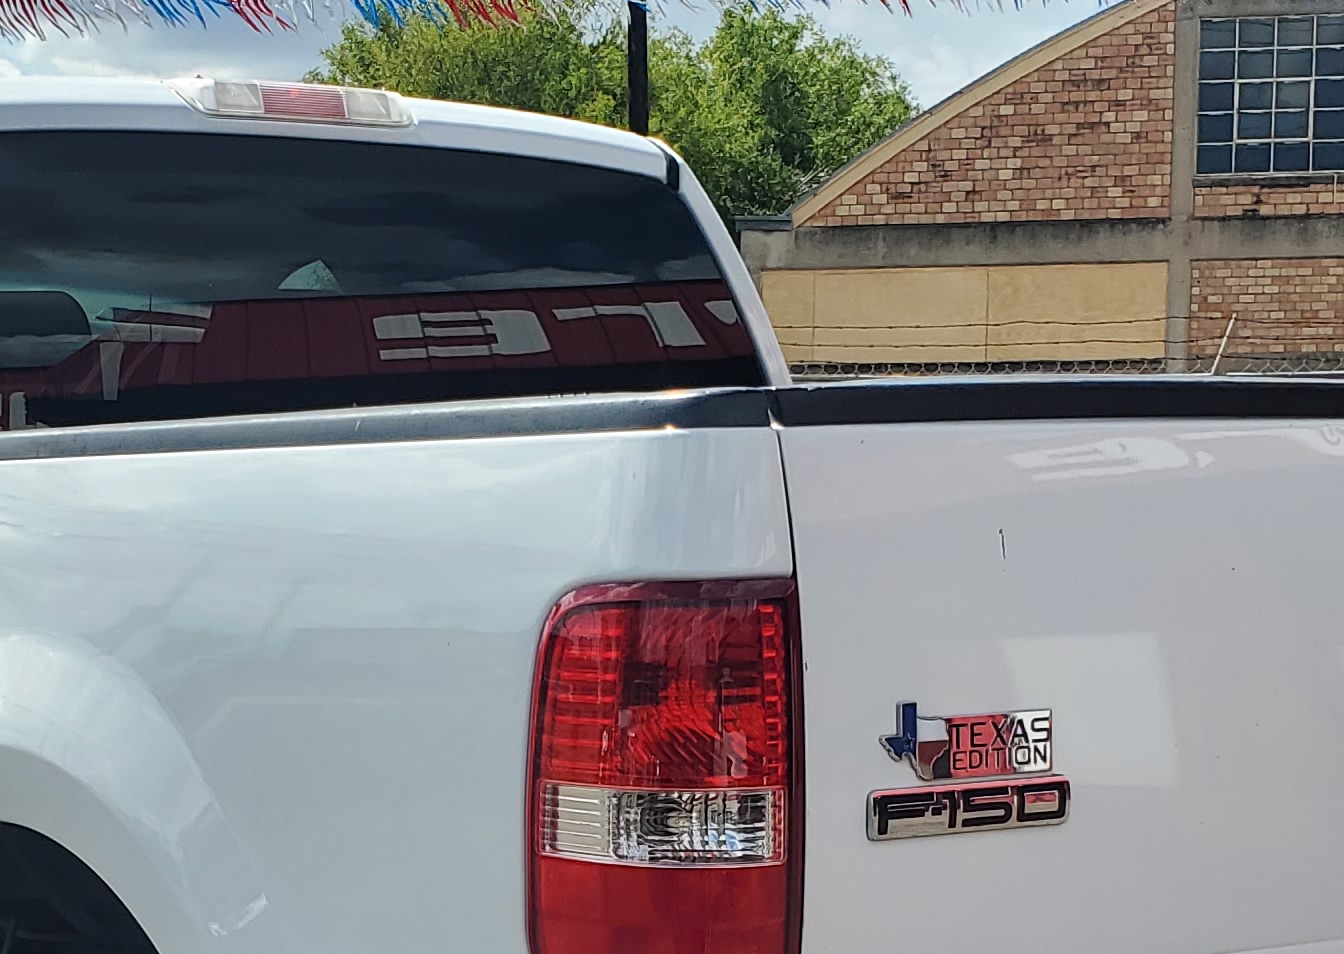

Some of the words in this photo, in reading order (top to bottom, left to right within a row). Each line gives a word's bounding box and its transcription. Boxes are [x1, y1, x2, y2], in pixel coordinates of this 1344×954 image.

[948, 717, 1050, 750] TEXAS
[952, 744, 1048, 771] EDITION
[873, 782, 1068, 836] F-150
